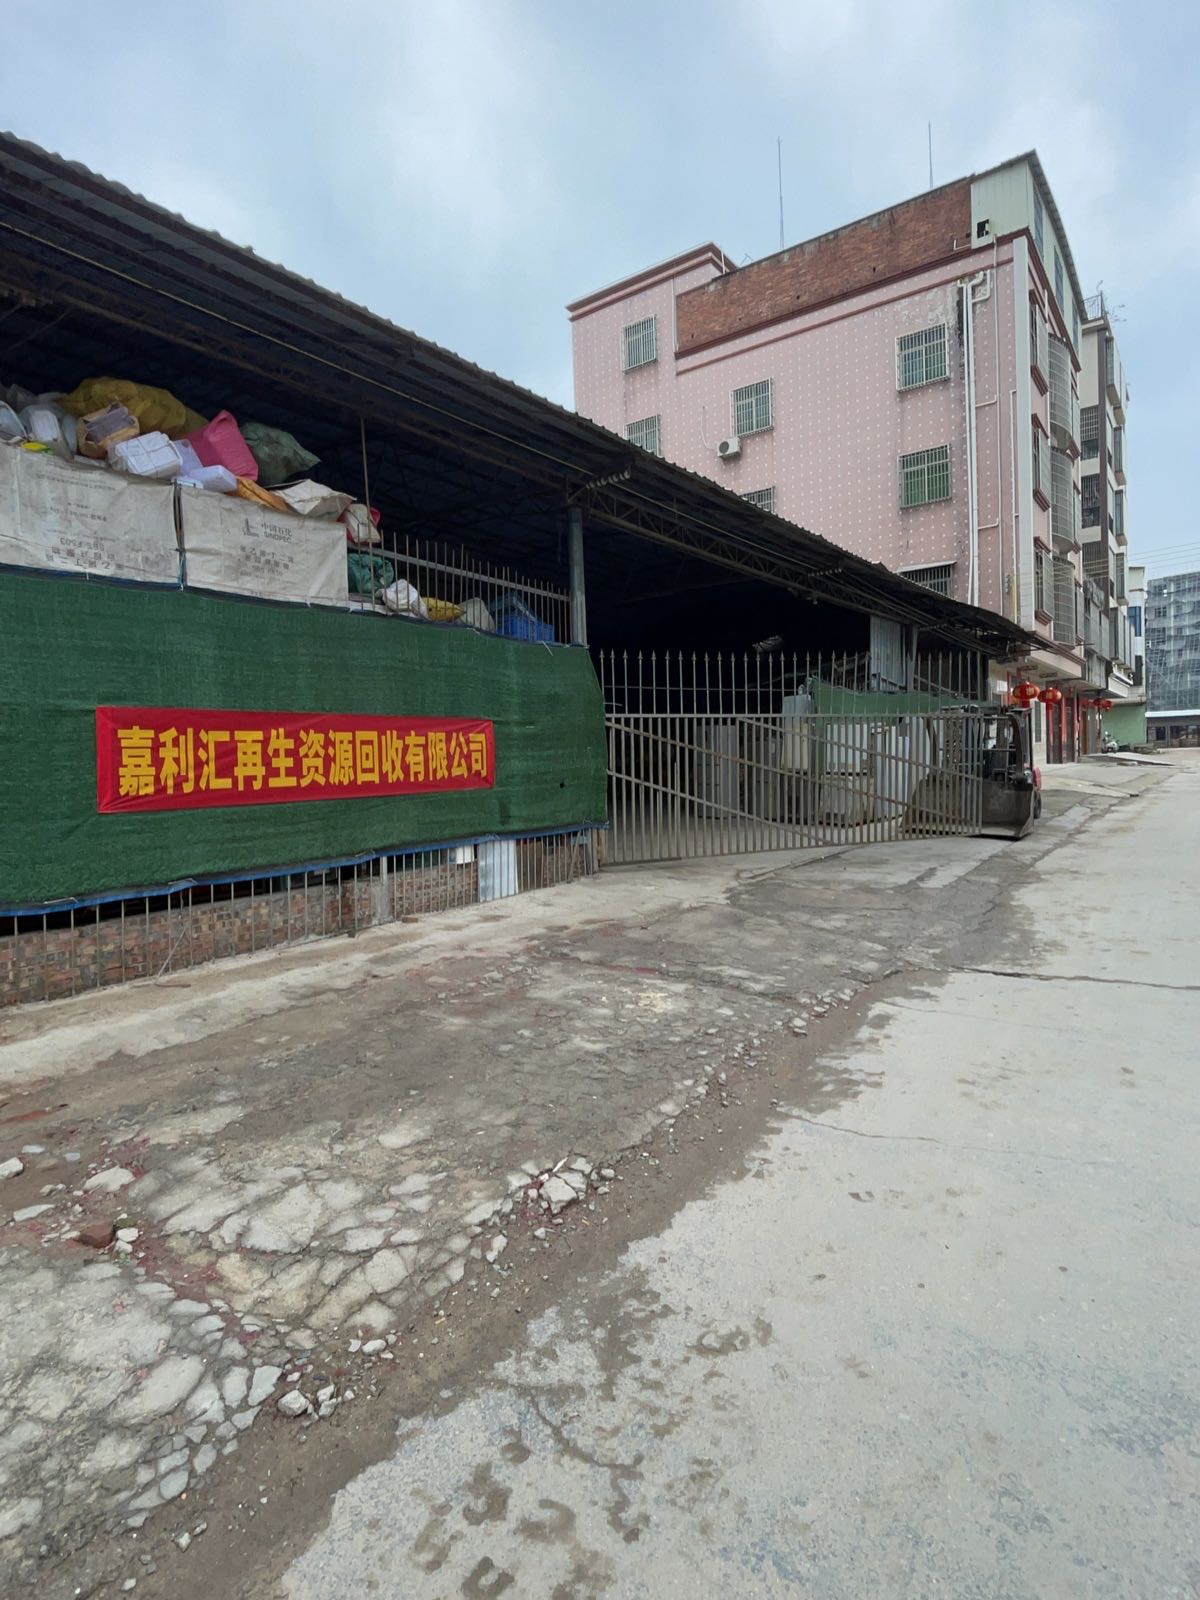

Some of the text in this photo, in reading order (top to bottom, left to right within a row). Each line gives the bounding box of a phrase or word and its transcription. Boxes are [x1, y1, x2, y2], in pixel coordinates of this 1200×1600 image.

[117, 725, 488, 796] 嘉利汇再生资源回收有限公司
